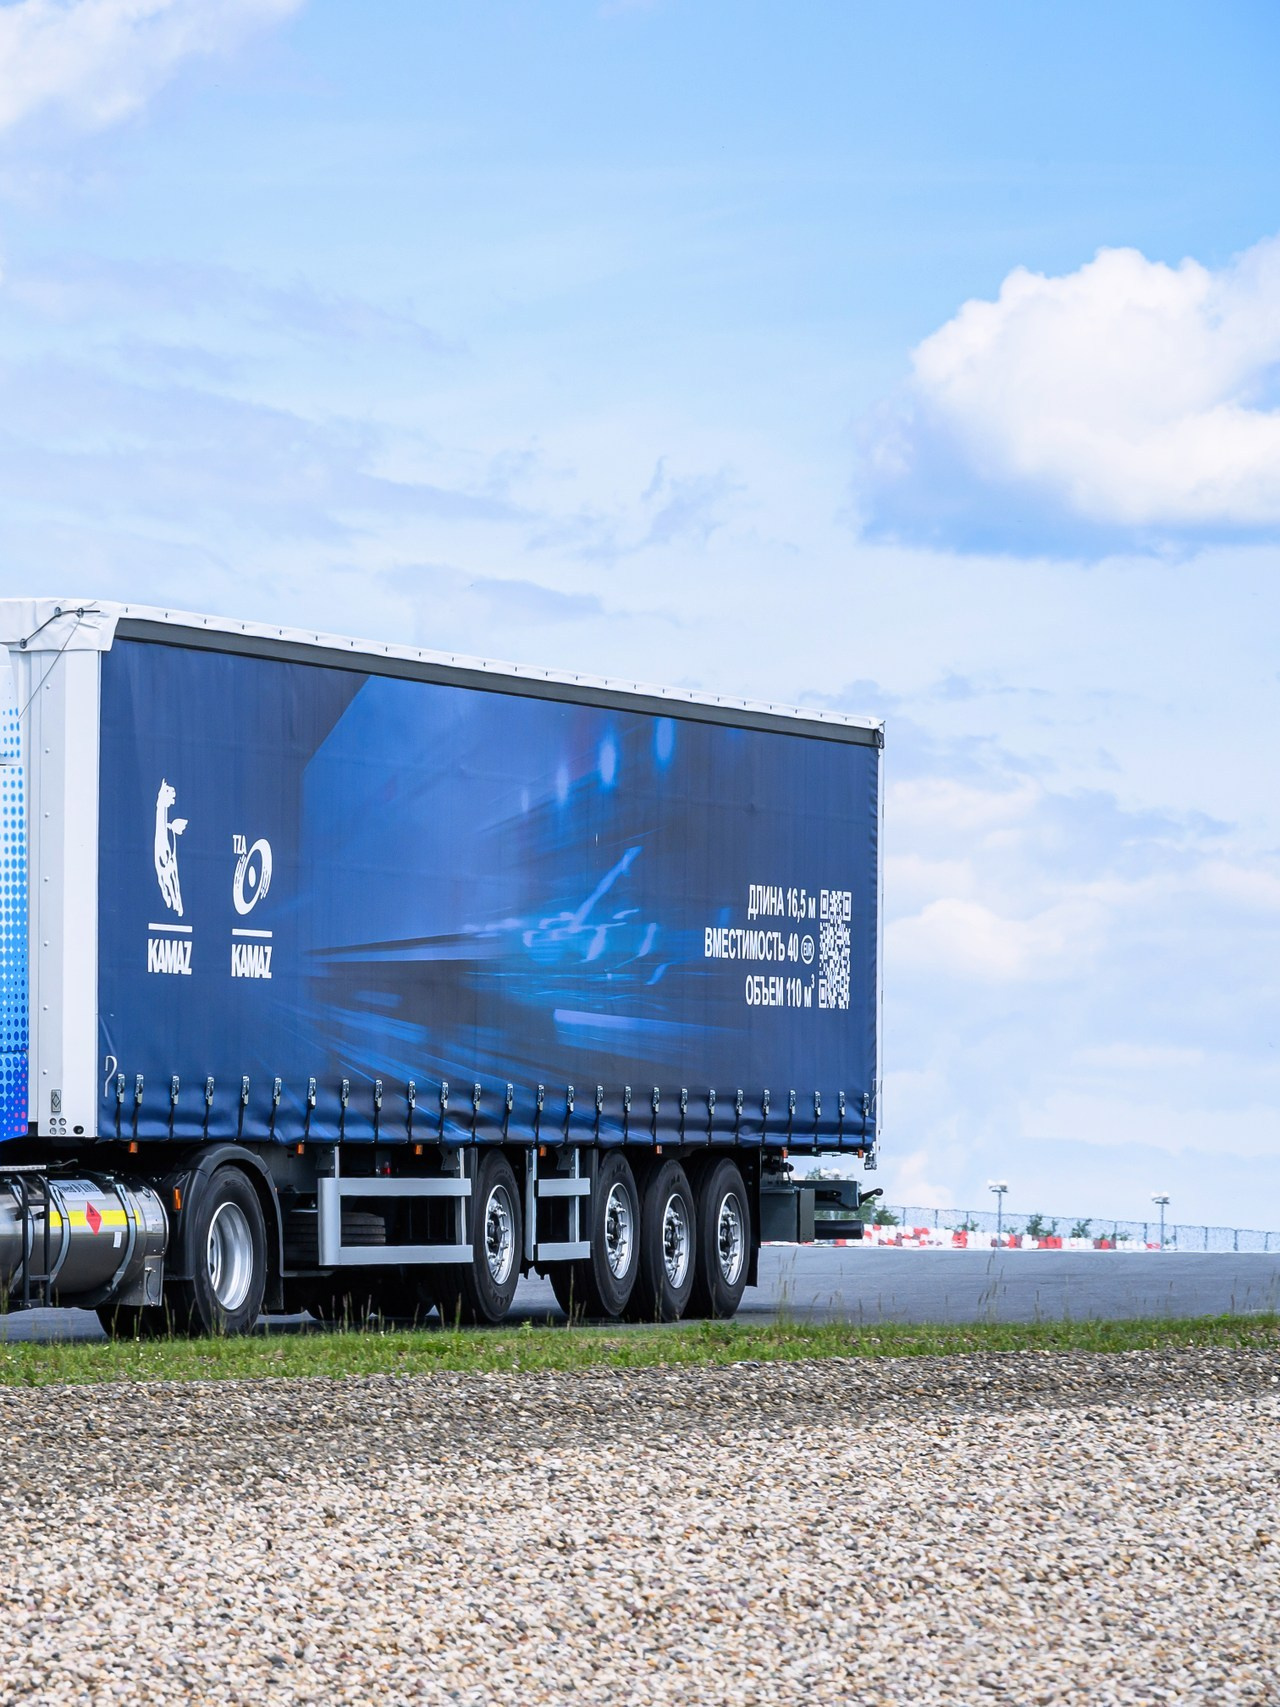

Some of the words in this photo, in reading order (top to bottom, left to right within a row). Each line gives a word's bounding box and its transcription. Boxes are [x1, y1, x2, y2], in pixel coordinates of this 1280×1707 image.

[232, 834, 247, 855] TZA
[748, 884, 785, 921] ДЛИНА
[786, 887, 806, 923] 16,5
[147, 938, 193, 975] KAMAZ
[231, 943, 273, 979] KAMAZ
[704, 927, 786, 962] ВМЕСТИМОСТЬ
[787, 933, 799, 962] 40
[745, 974, 784, 1007] ОБЪЕМ
[786, 978, 802, 1008] 110
